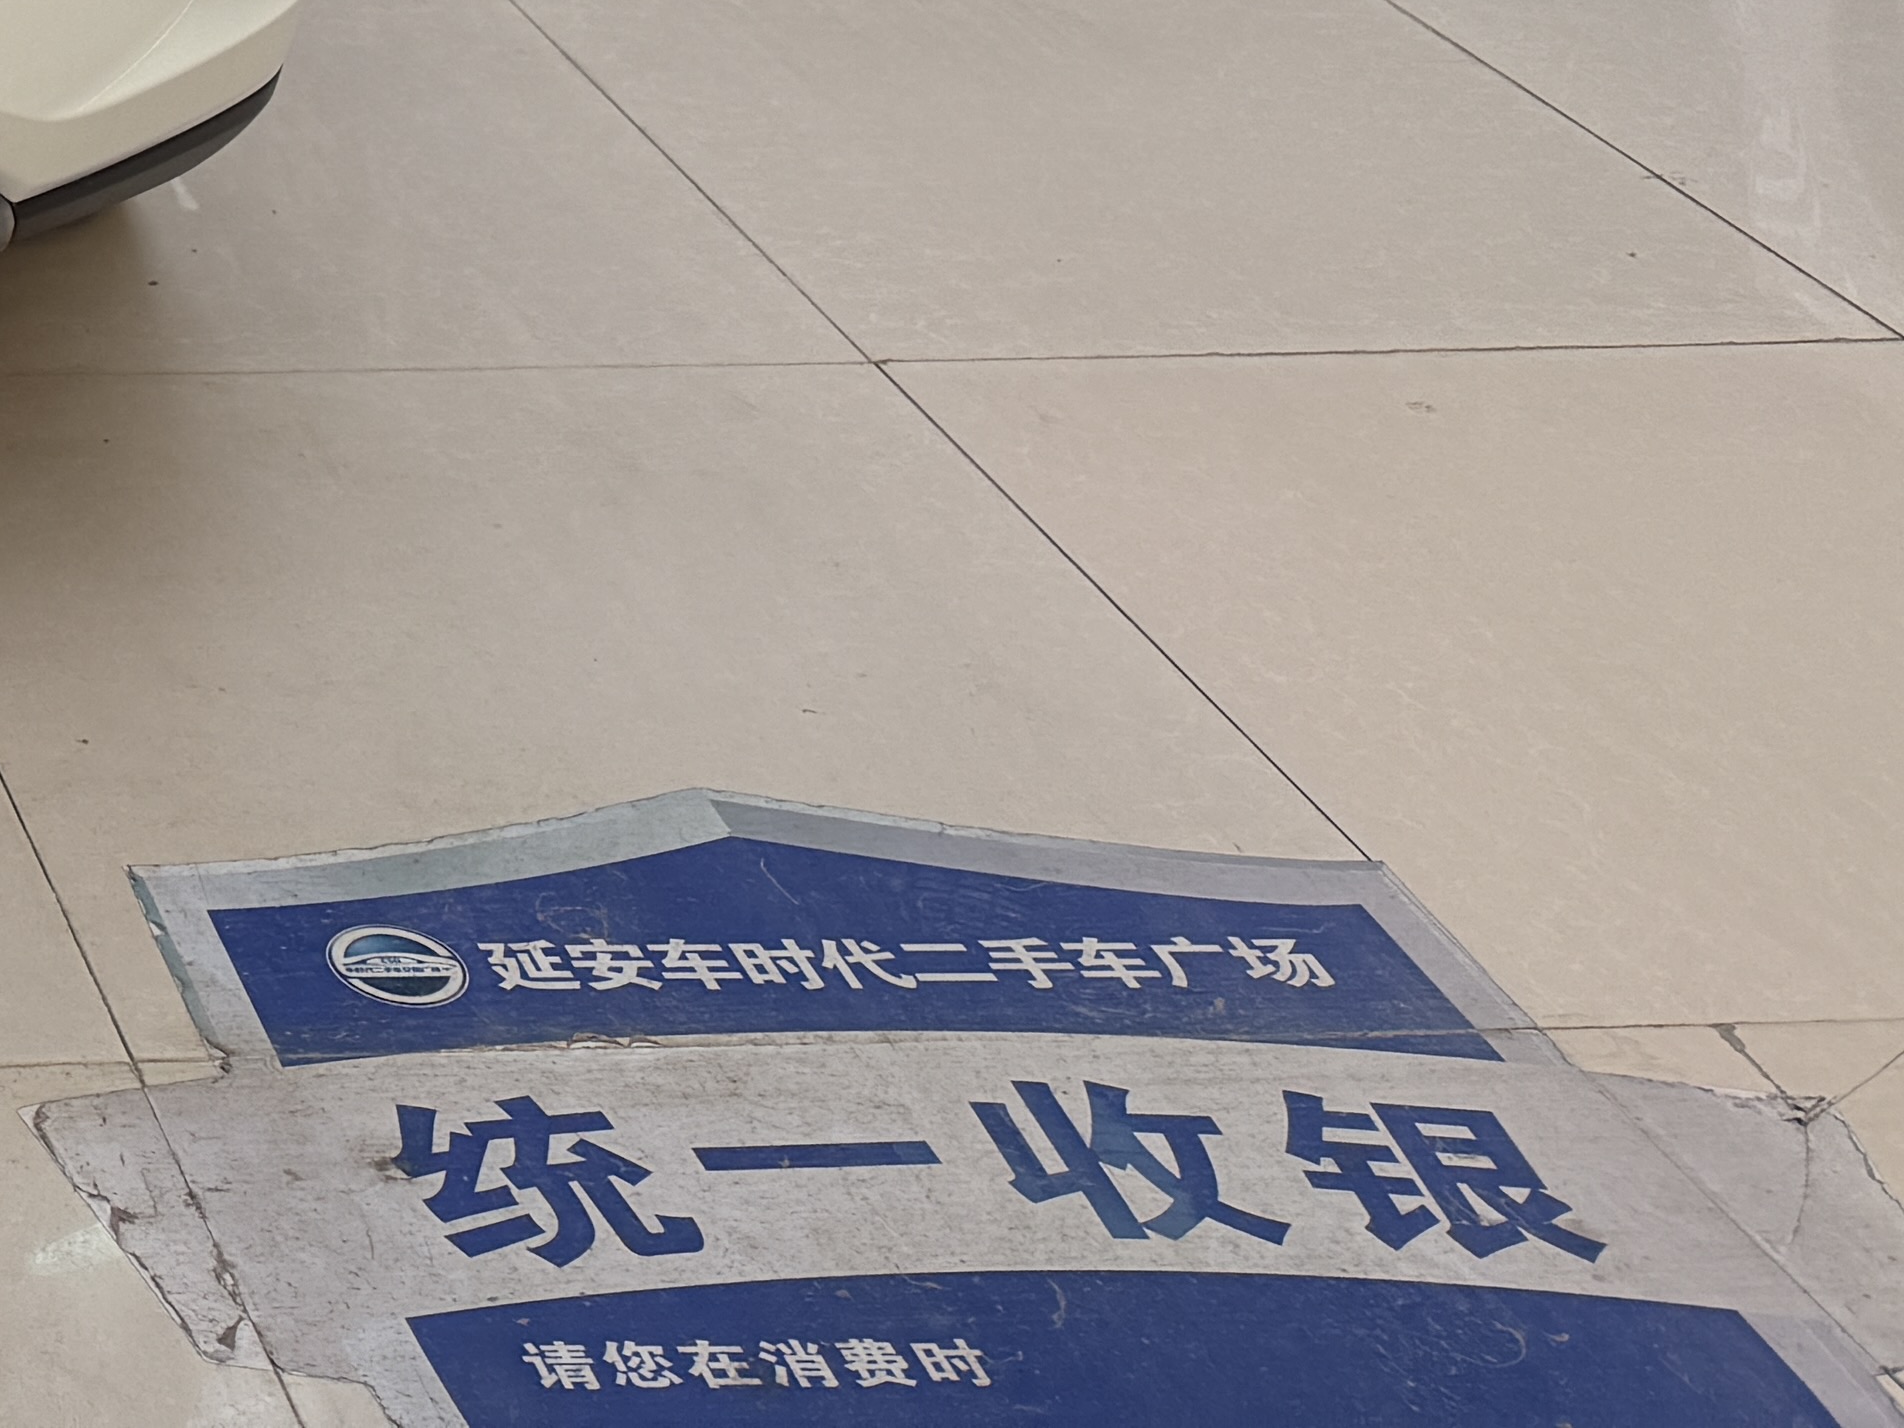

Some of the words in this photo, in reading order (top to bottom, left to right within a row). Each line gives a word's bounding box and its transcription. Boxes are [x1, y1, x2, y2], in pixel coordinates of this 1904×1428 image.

[477, 936, 1335, 992] 延安车时代二手车广场
[393, 1079, 1608, 1268] 统一收银
[521, 1338, 993, 1391] 请您在消费时
